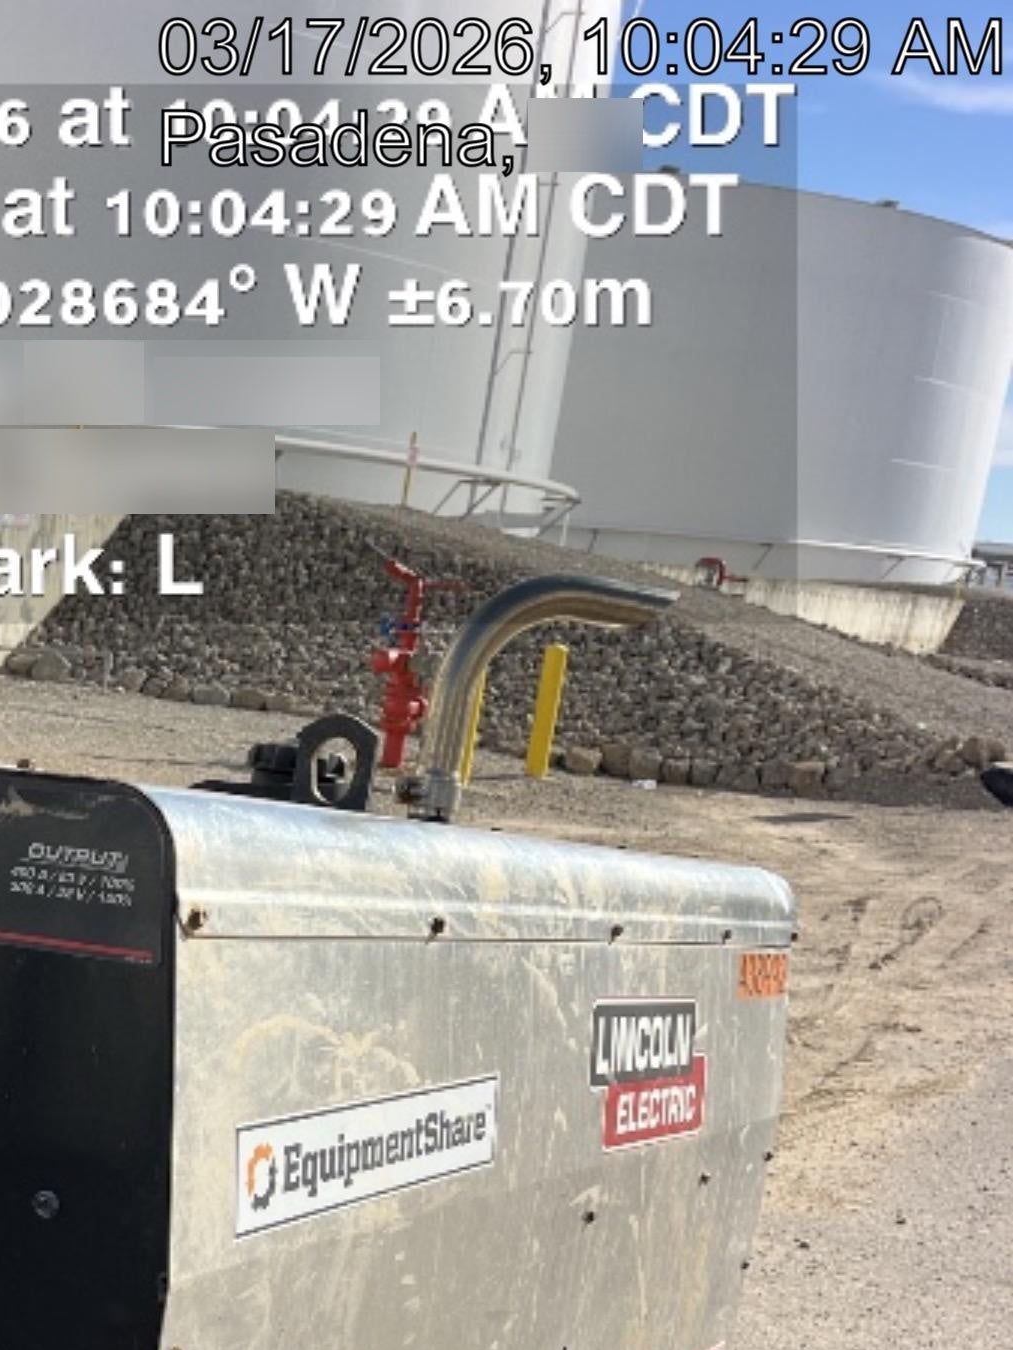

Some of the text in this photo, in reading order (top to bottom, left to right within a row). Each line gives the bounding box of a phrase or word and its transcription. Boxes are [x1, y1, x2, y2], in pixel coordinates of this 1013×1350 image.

[595, 1013, 693, 1076] LINCOLN
[616, 1084, 697, 1135] ELECTRIC
[281, 1109, 487, 1197] EquipmentShare
